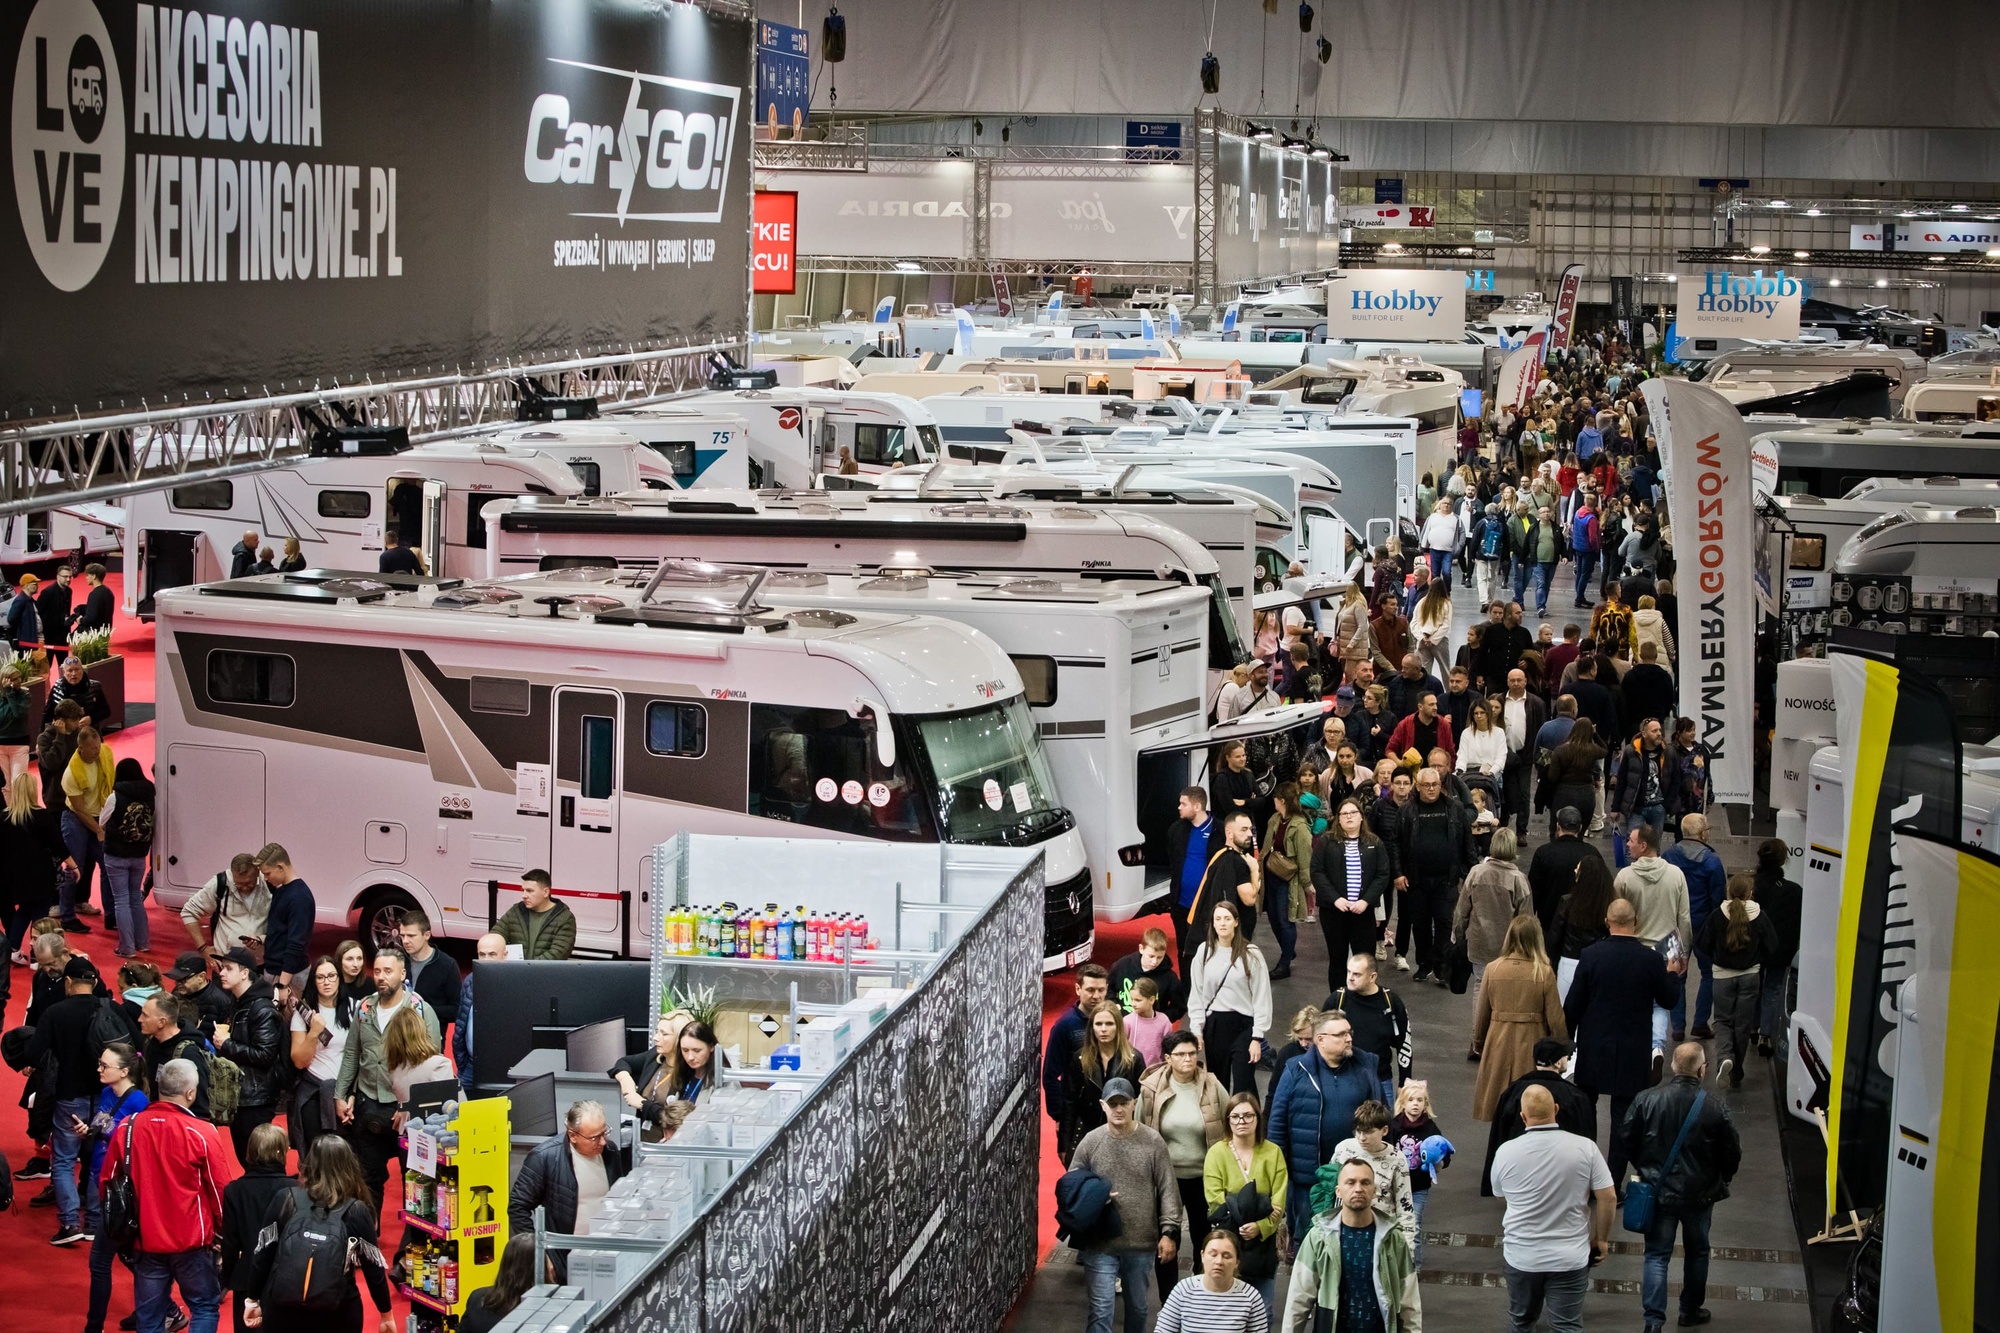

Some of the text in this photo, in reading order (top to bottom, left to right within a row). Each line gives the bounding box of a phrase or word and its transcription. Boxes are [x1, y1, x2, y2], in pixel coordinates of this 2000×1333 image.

[134, 3, 322, 147] AKCESORIA
[1140, 124, 1149, 134] D
[134, 153, 403, 283] KEMPINGOWE.PL
[1946, 234, 2000, 243] ADRI
[554, 233, 715, 271] SPRZEDAŻ WYNAJEM SERWIS SKLEP
[753, 252, 788, 271] CU!
[1703, 269, 1816, 305] Hobby
[1351, 289, 1443, 317] Hobby
[1554, 275, 1580, 350] KABE
[1697, 292, 1780, 319] Hobby
[470, 483, 493, 491] FRANKIA
[1081, 559, 1112, 568] FRANKIA
[711, 687, 747, 699] FRANKIA
[976, 678, 1006, 698] FRANKIA
[1784, 697, 1837, 712] NOWOŚĆ
[1783, 769, 1799, 782] NEW
